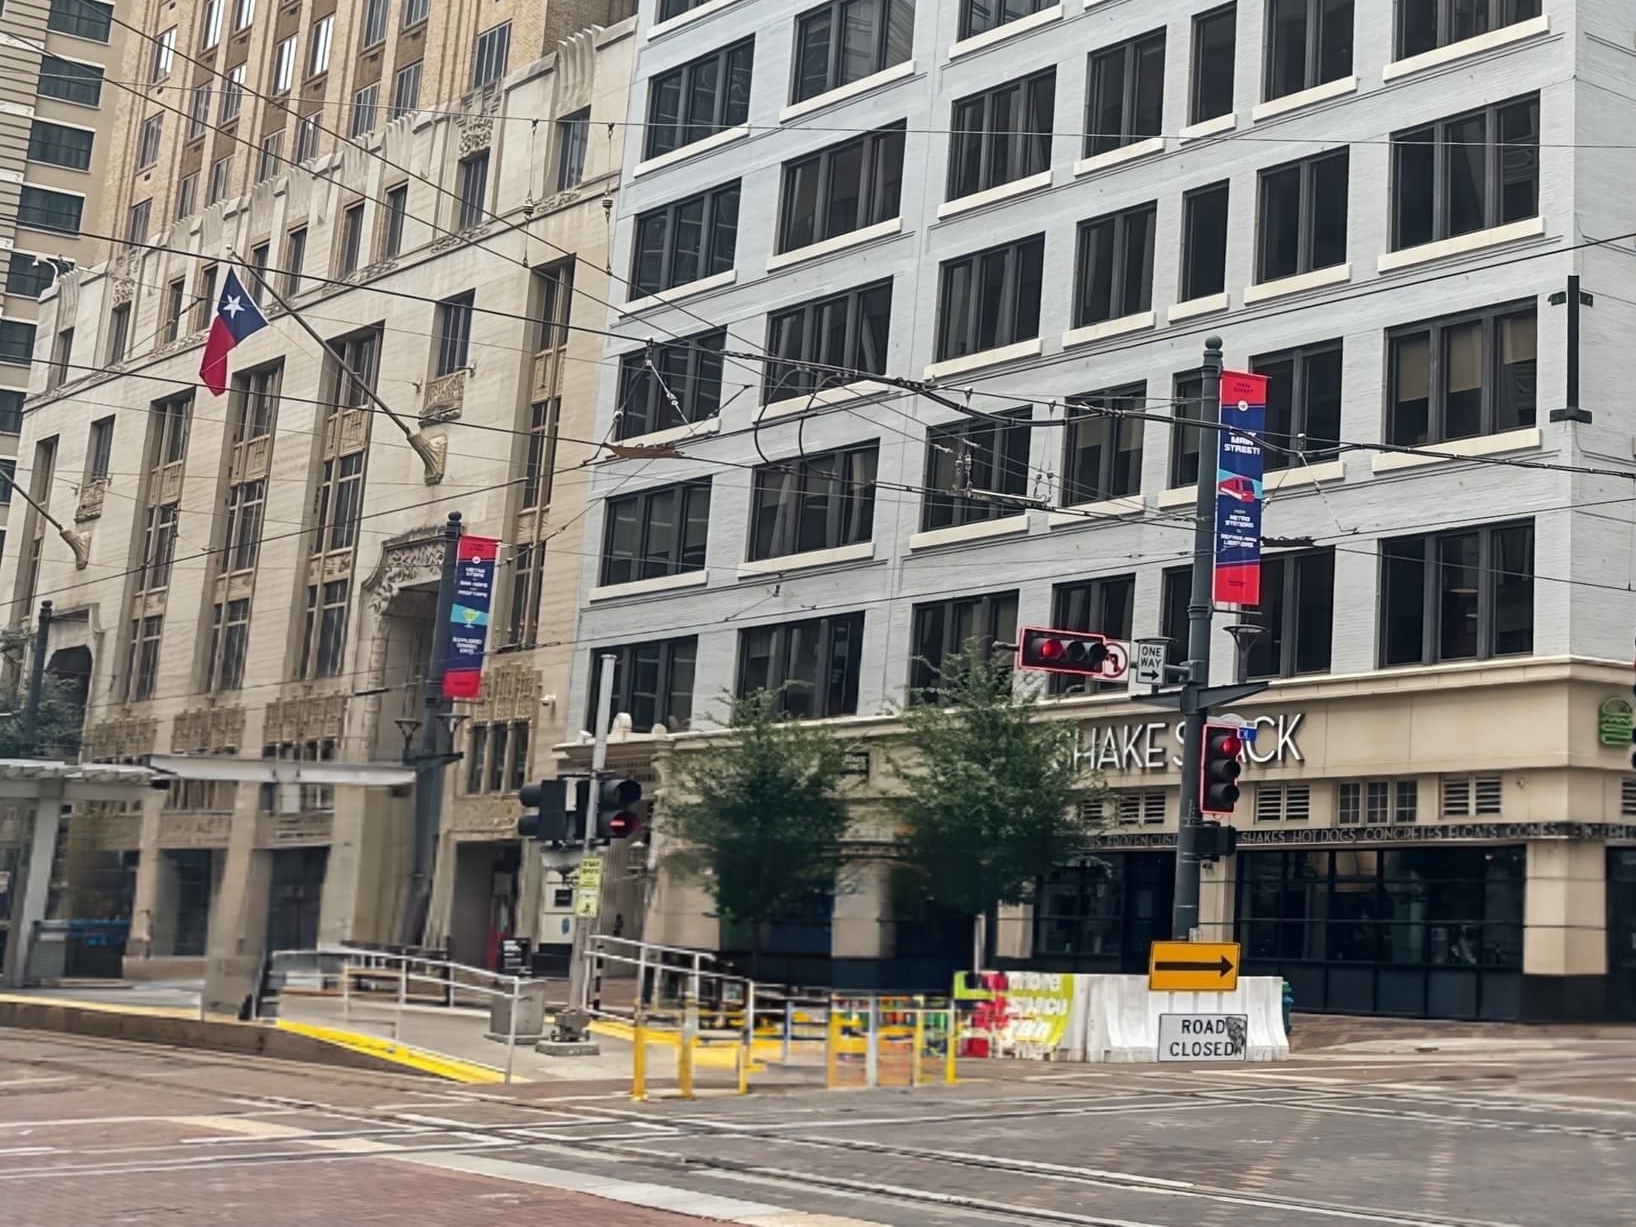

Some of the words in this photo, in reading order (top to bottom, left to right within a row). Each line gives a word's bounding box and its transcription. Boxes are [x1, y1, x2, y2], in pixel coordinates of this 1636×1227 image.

[1142, 646, 1162, 657] ONE
[1141, 658, 1161, 668] WAY
[1072, 722, 1166, 771] HAKE
[1107, 834, 1148, 846] FROZEN
[1151, 833, 1178, 846] CUST
[1241, 830, 1286, 844] SHAKES
[1293, 830, 1317, 843] HOT
[1320, 828, 1356, 843] DOGS
[1363, 825, 1442, 841] CONCRETES
[1181, 1019, 1226, 1034] ROAD
[1169, 1041, 1235, 1057] CLOSED
